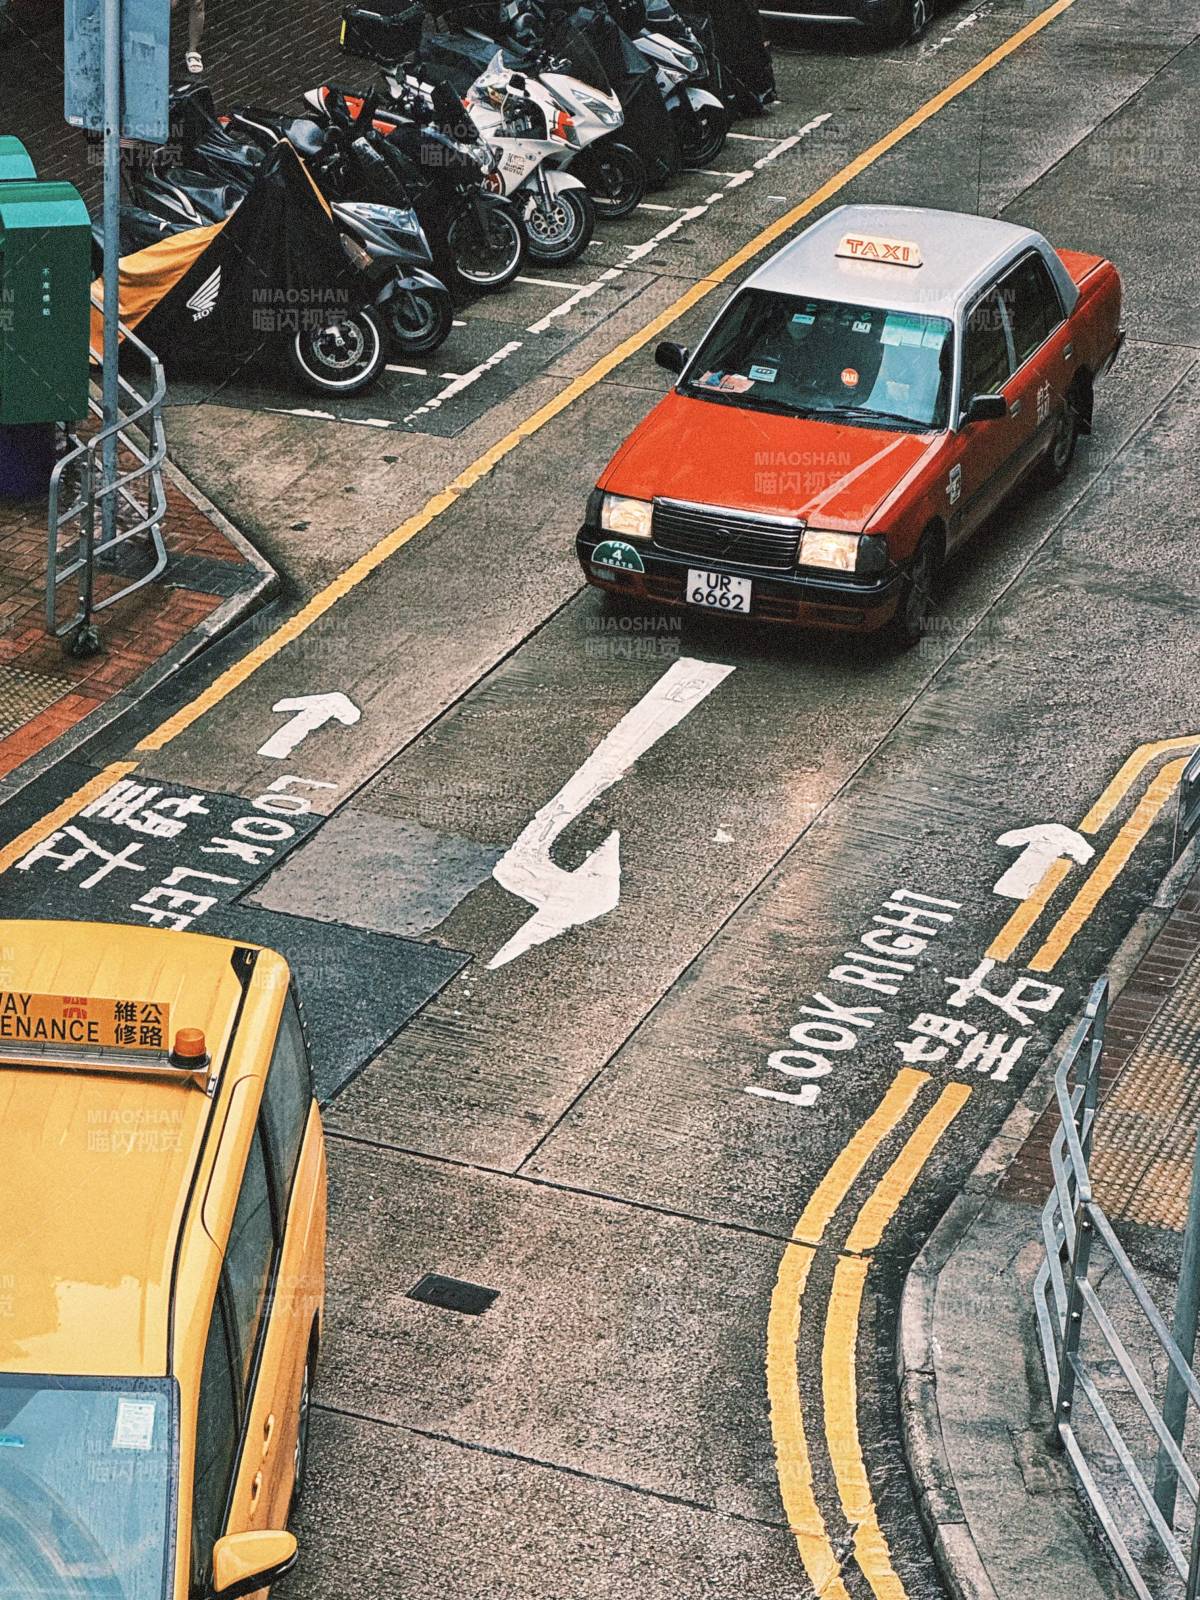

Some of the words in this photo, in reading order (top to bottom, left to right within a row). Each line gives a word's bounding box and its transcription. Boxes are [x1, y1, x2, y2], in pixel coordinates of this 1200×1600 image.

[846, 238, 910, 262] TAXI
[612, 549, 622, 560] 4
[706, 573, 732, 592] UR
[692, 586, 744, 611] 6662
[200, 775, 339, 865] LOOK
[130, 866, 240, 932] LEF
[744, 992, 884, 1107] LOOK
[828, 889, 963, 995] RIGHT
